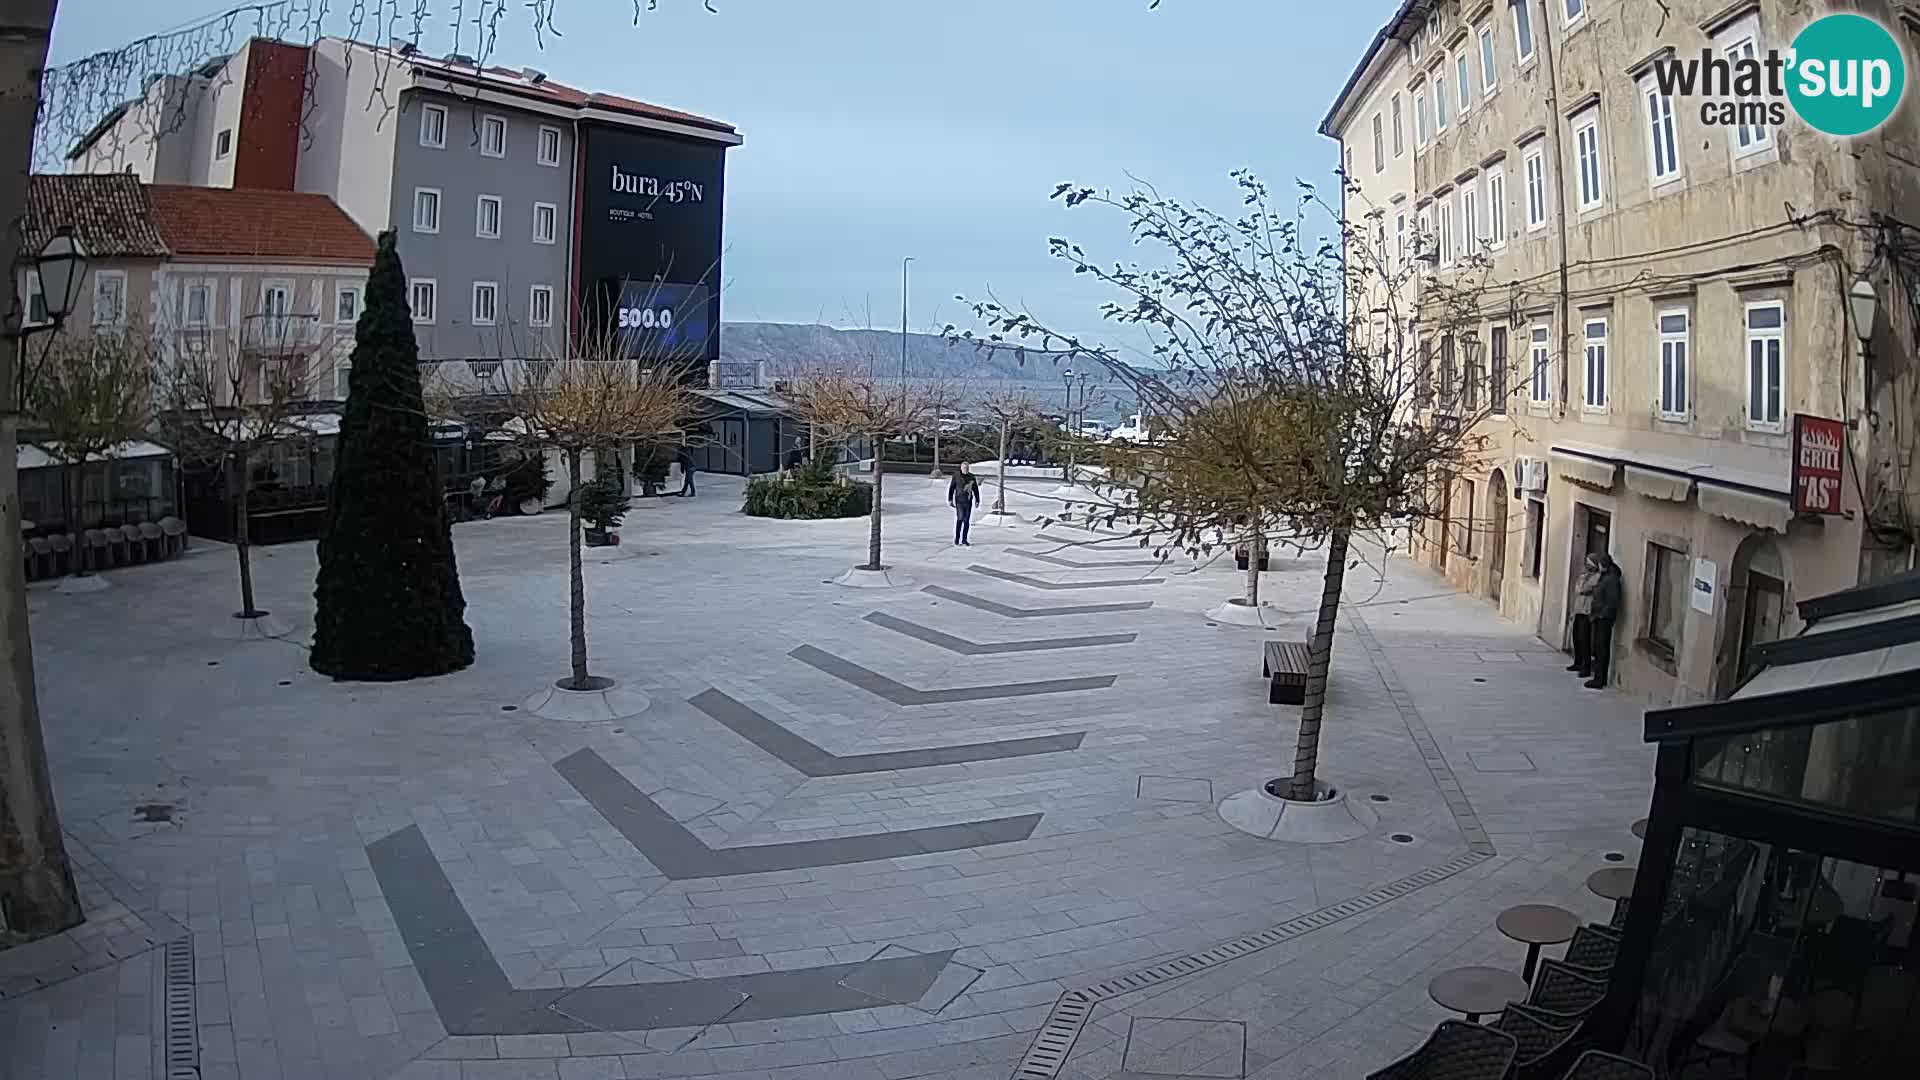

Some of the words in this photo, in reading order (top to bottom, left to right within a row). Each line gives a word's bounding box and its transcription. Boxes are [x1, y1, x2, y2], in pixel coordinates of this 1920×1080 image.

[612, 165, 658, 196] bura
[618, 307, 672, 329] 500.0
[1800, 447, 1840, 472] GRILL
